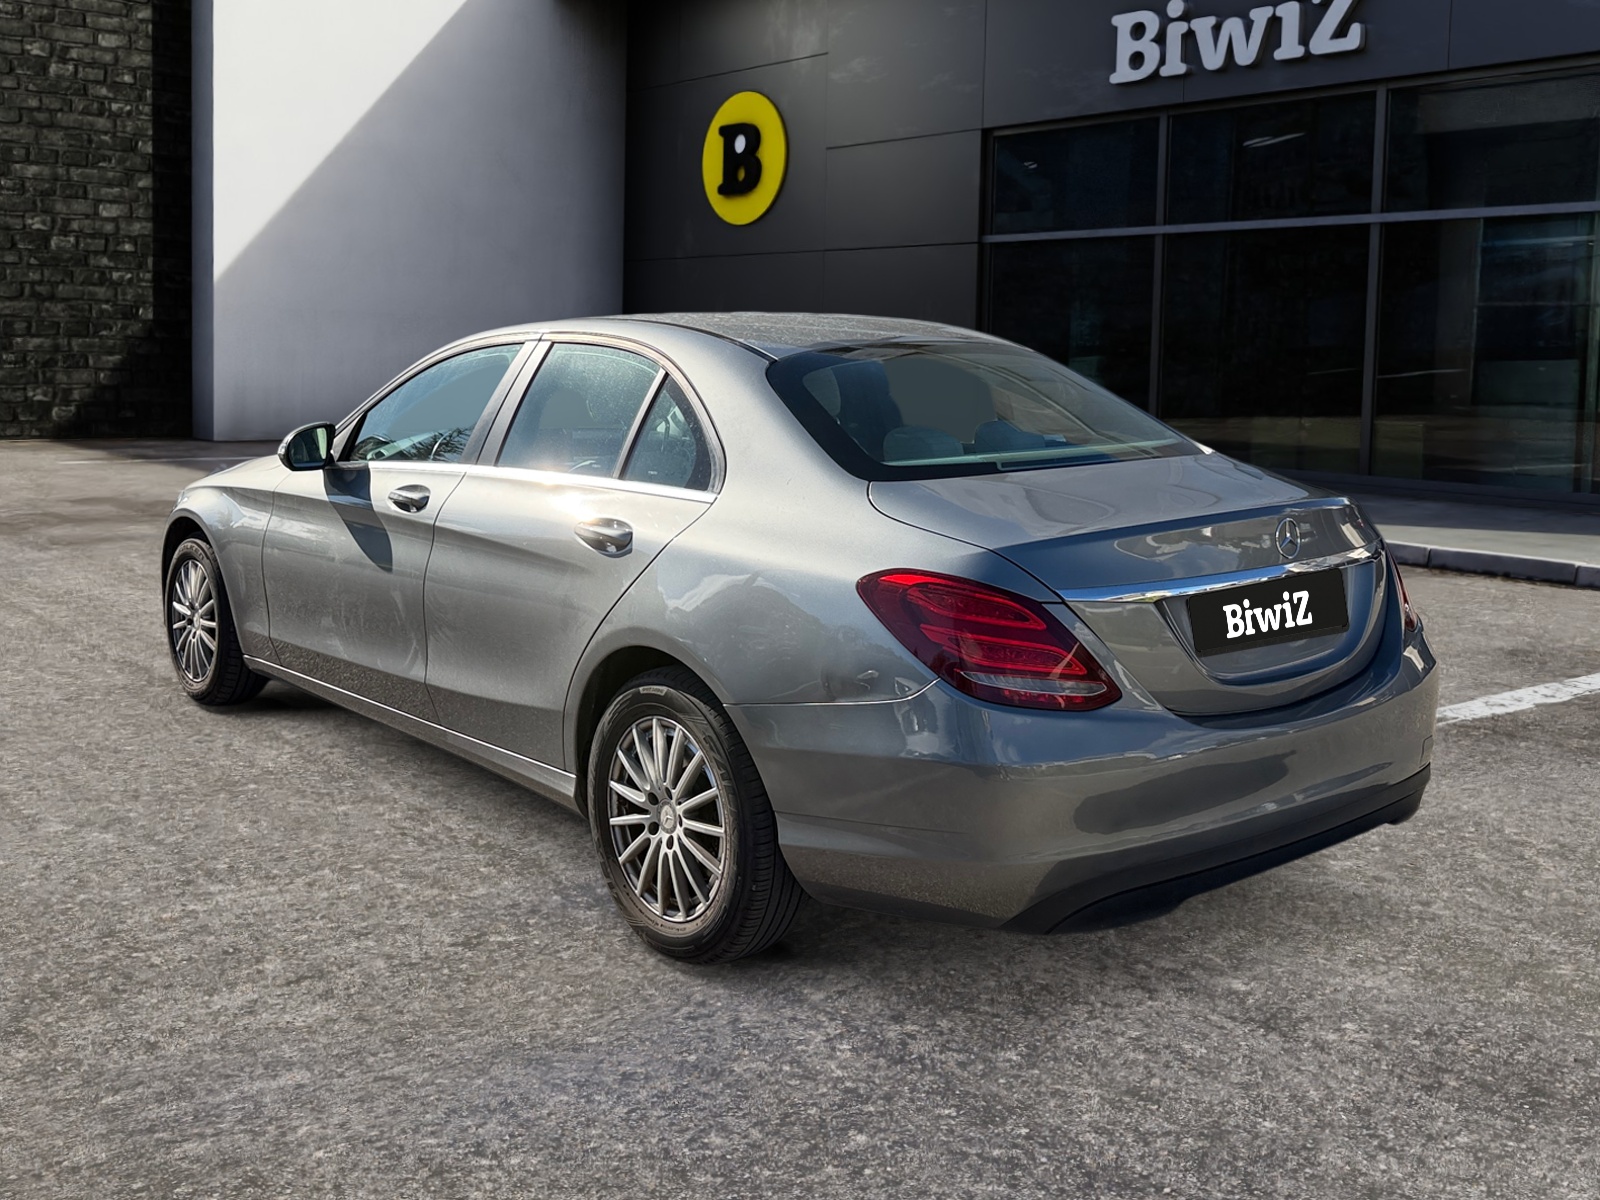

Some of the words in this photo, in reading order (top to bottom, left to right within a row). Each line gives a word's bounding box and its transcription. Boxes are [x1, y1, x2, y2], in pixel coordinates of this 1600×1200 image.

[1109, 0, 1364, 84] BiwiZ
[717, 122, 762, 197] B
[1222, 590, 1313, 639] BiwiZ
